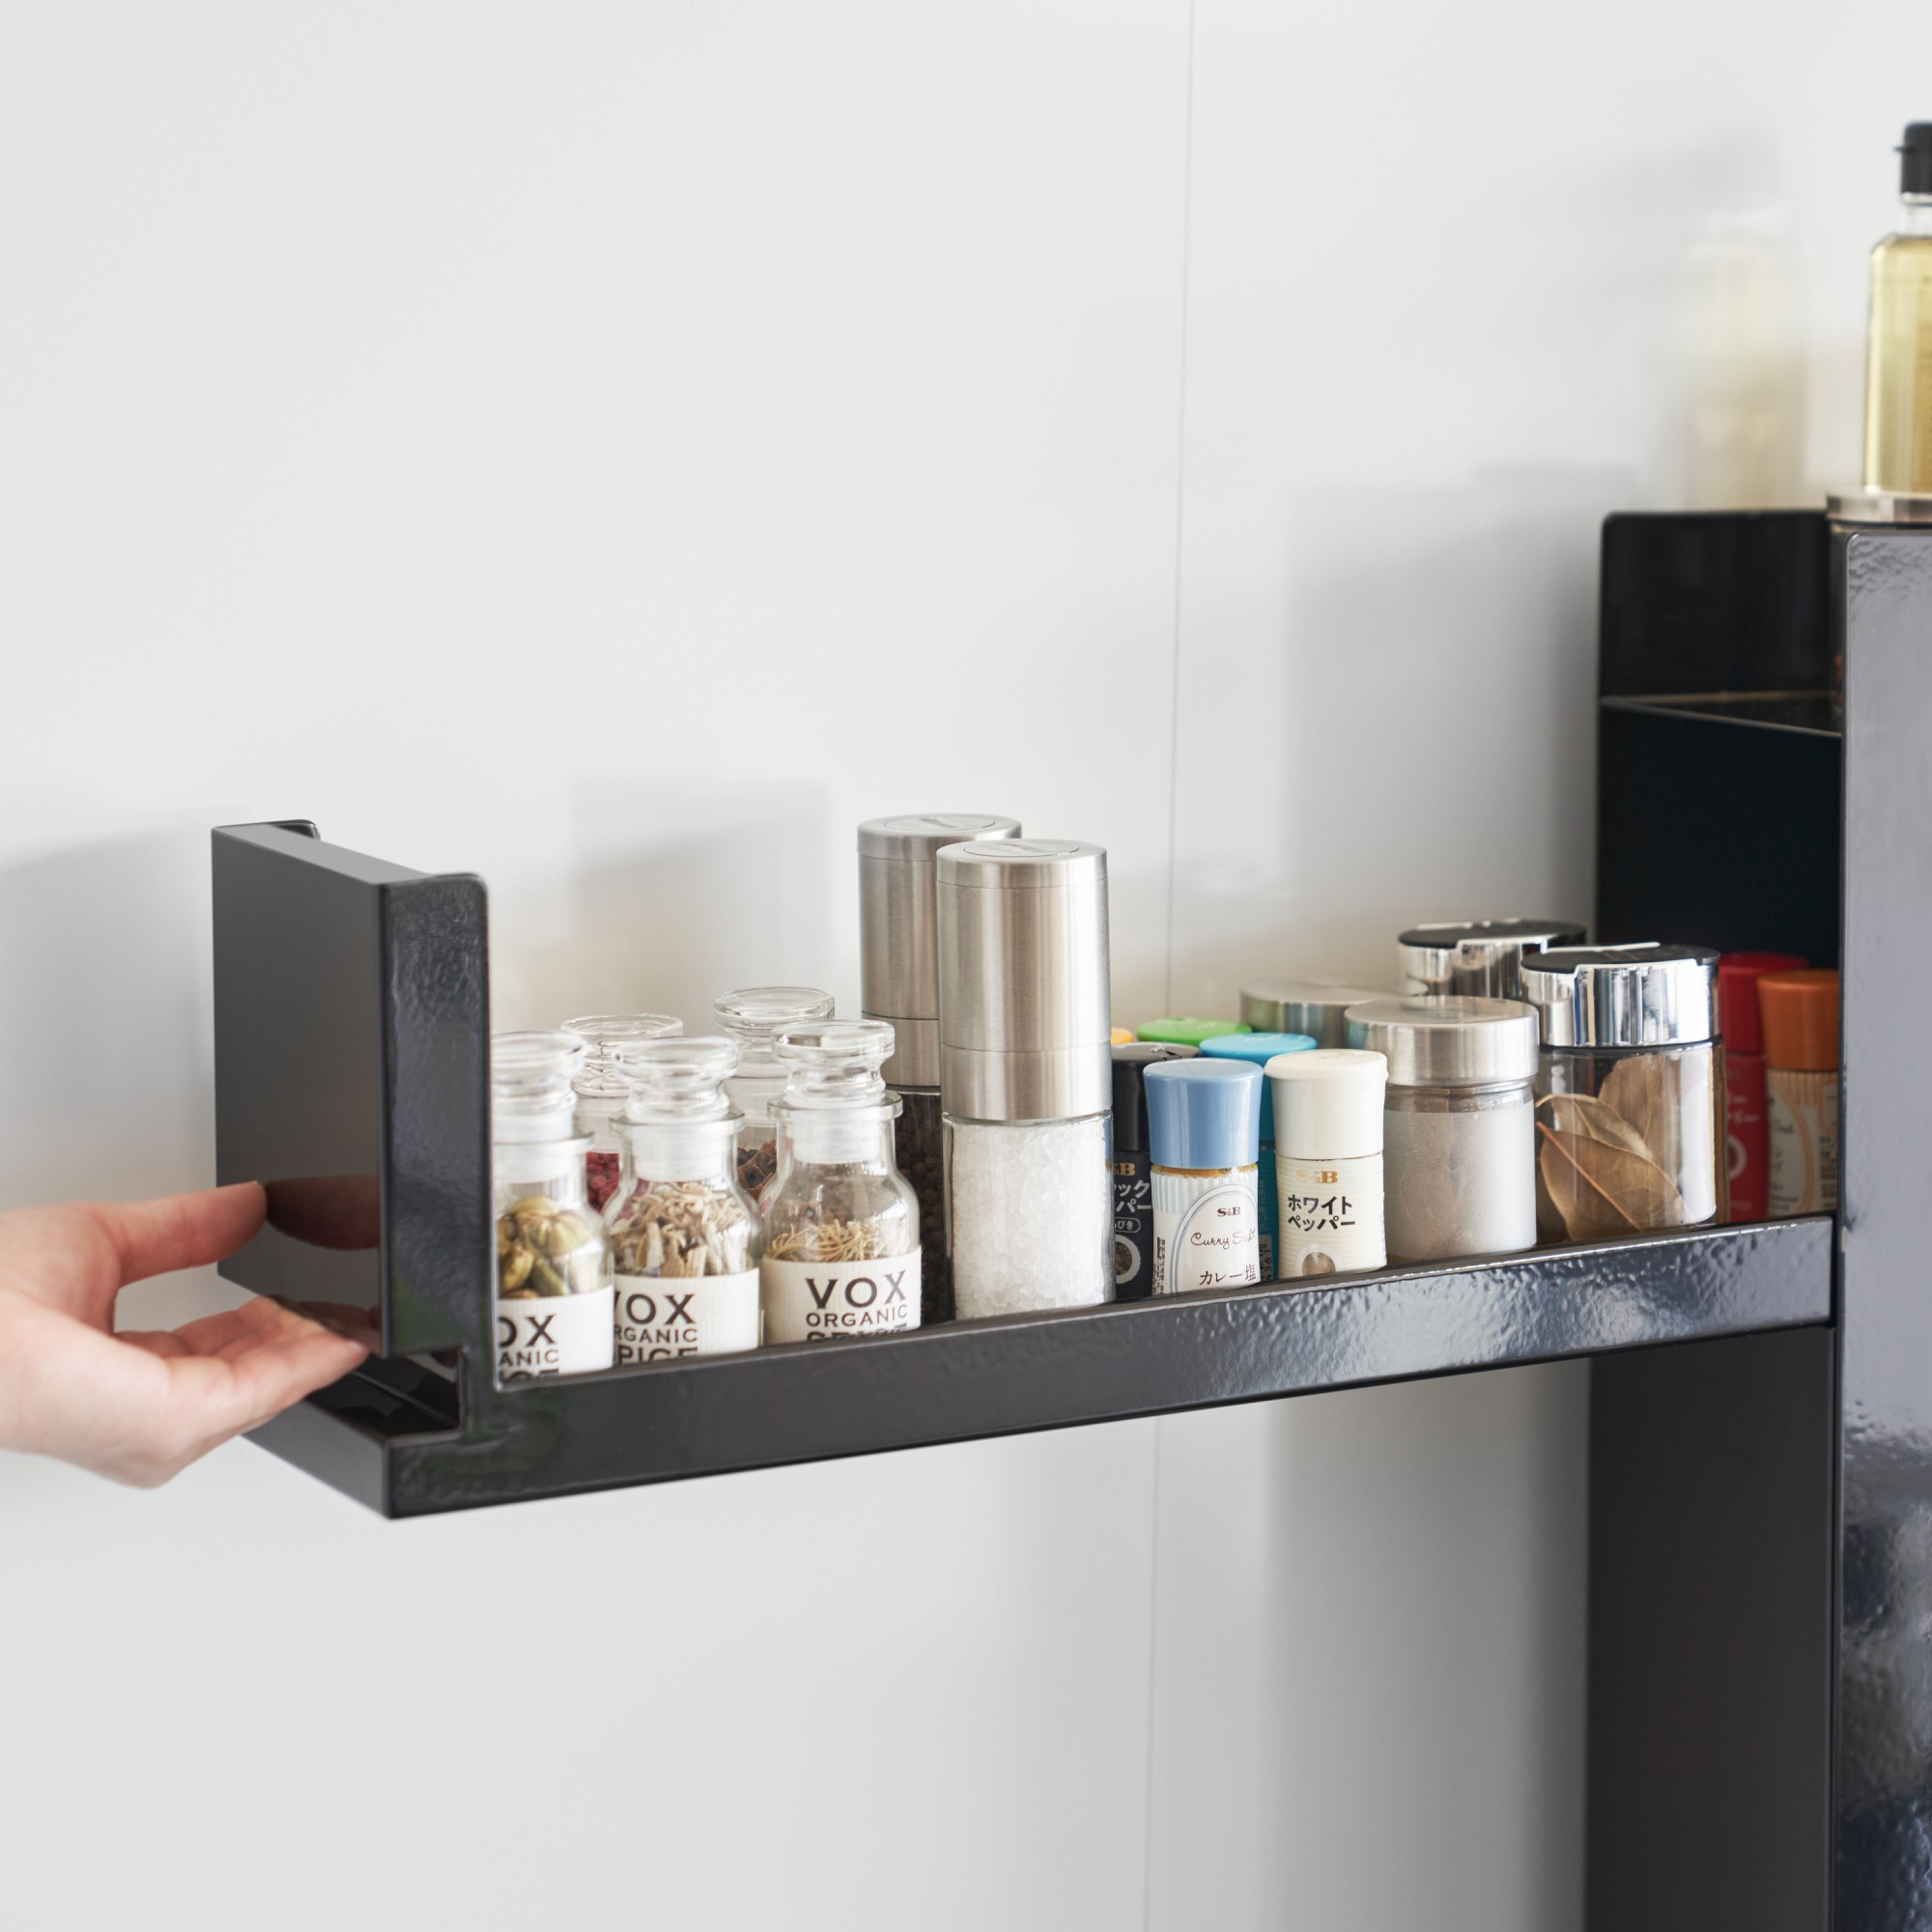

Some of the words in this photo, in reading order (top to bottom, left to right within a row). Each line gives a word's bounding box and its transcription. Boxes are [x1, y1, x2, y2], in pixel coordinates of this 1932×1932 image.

[1296, 1169, 1338, 1183] S&B
[1114, 1179, 1150, 1198] ック
[1217, 1207, 1241, 1217] S&B
[1288, 1194, 1352, 1215] ホワイト
[1115, 1220, 1134, 1231] びき
[1288, 1214, 1355, 1232] ペッパー
[1190, 1232, 1230, 1250] Curry
[1232, 1228, 1256, 1245] Salt
[1199, 1264, 1257, 1286] カレー塩
[805, 1269, 906, 1310] VOX
[806, 1304, 908, 1328] ORGANIC
